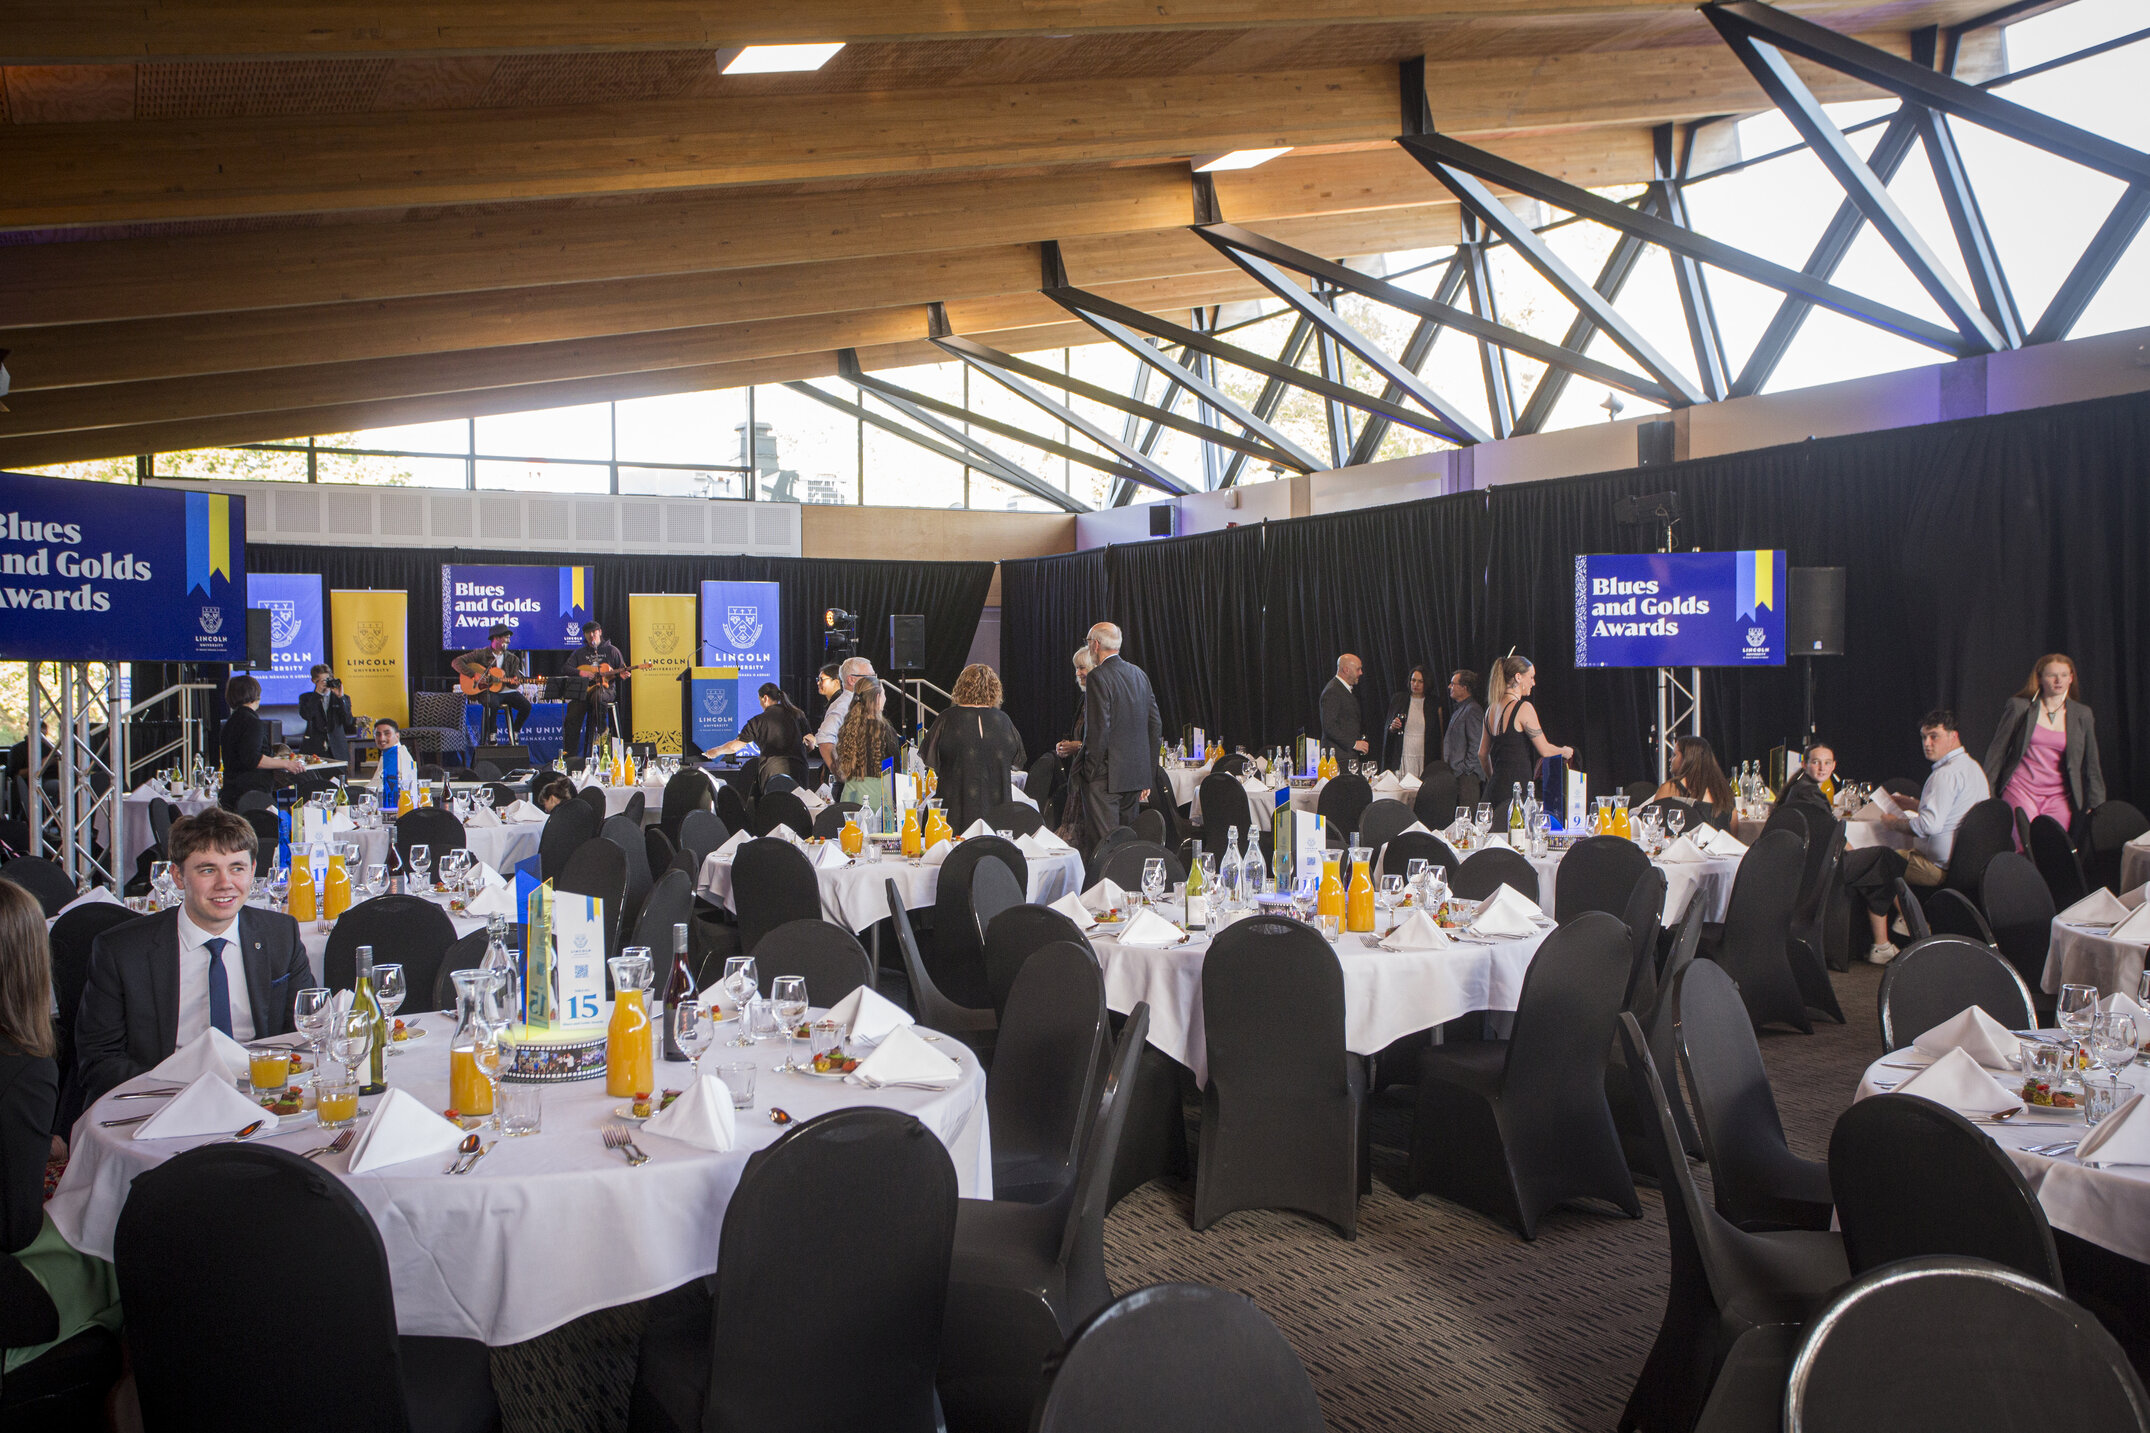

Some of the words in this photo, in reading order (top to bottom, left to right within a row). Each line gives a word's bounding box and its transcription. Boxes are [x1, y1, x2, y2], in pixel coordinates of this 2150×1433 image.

[0, 548, 49, 576] nd
[56, 550, 152, 581] Golds
[455, 582, 505, 596] Blues
[1591, 577, 1659, 596] Blues
[455, 598, 488, 612] and
[491, 598, 541, 612] Golds
[1591, 597, 1637, 616] and
[1641, 596, 1710, 615] Golds
[455, 613, 520, 627] Awards
[1591, 619, 1679, 637] Awards
[271, 652, 312, 662] COLN
[715, 653, 770, 662] LINCOLN
[1573, 815, 1581, 826] 9
[567, 993, 599, 1019] 15
